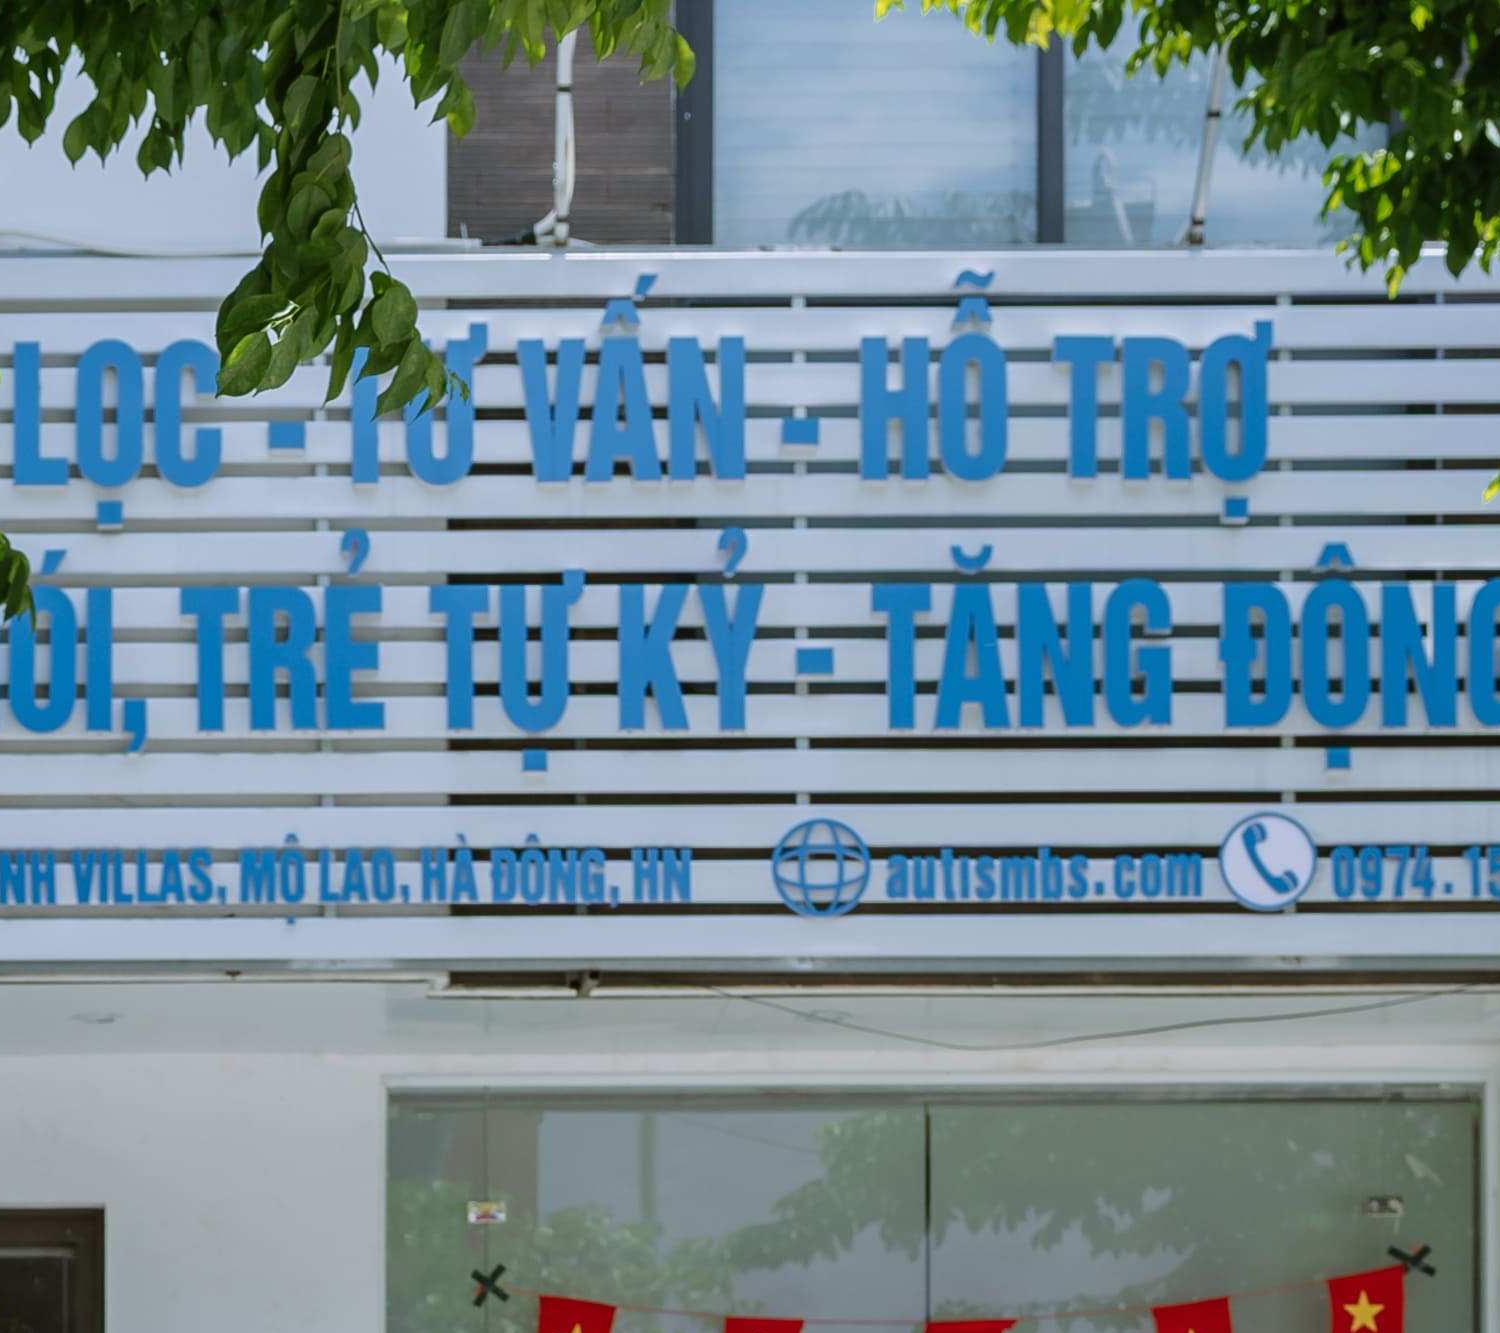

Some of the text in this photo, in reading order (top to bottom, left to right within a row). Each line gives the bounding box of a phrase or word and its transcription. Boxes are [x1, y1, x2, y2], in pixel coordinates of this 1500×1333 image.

[12, 338, 223, 529] LỌC
[516, 273, 746, 482] VẤN
[860, 269, 1007, 482] HỖ
[1053, 320, 1274, 523] TRỢ
[180, 527, 386, 732] TRẺ
[429, 568, 586, 772] TỰ
[617, 526, 766, 732] KỶ
[871, 543, 1173, 731] TĂNG
[69, 847, 228, 908] VILLAS,
[238, 832, 307, 926] MỘ
[317, 847, 410, 908] LAO,
[420, 832, 478, 905] HÀ
[489, 832, 621, 909] ĐÔNG,
[631, 846, 693, 905] HN
[884, 846, 1202, 900] autismbs.com
